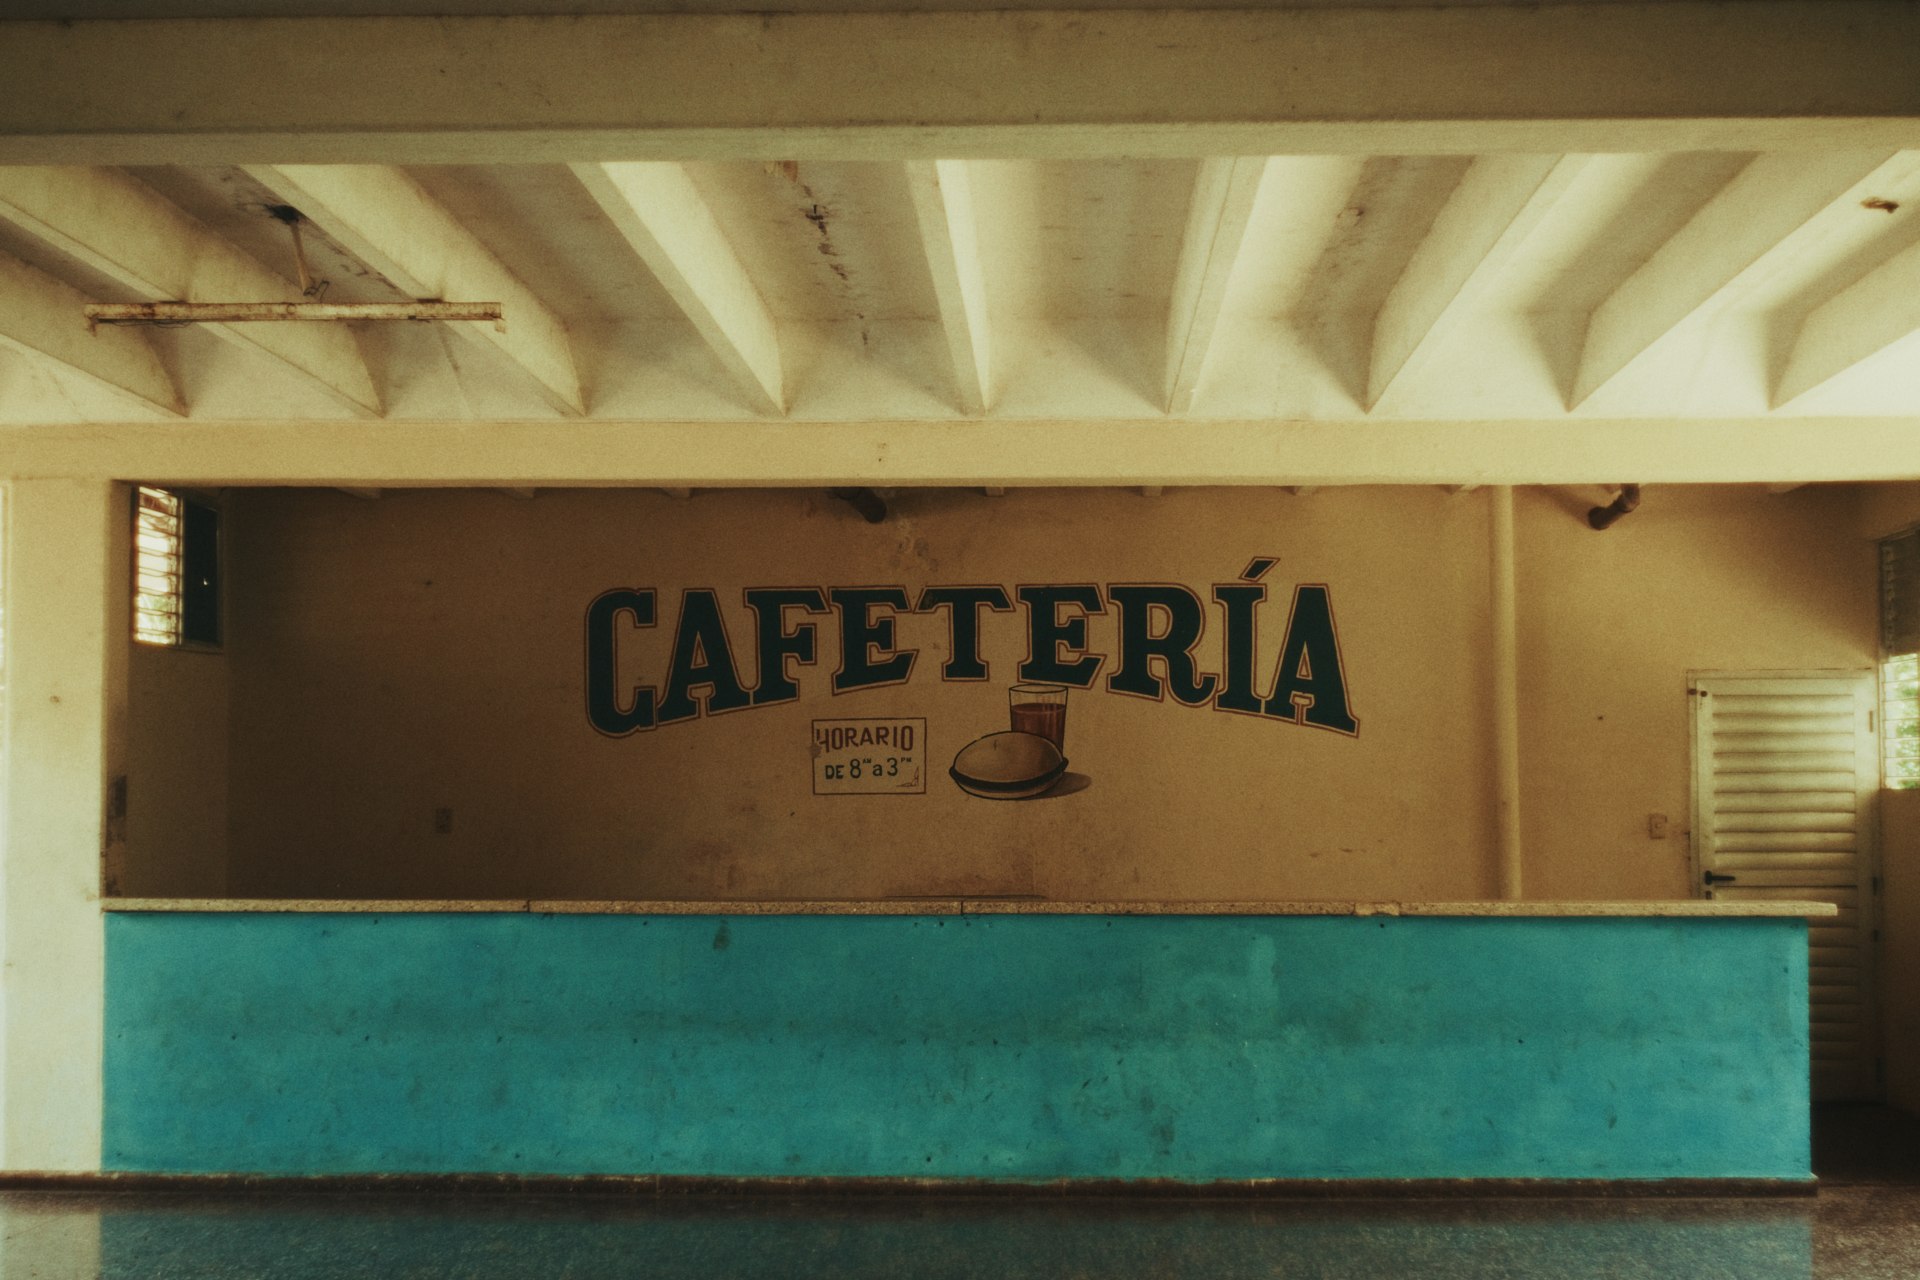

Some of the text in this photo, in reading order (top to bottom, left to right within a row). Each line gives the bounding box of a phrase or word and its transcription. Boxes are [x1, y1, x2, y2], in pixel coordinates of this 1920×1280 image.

[584, 557, 1361, 738] CAFETERÍA
[815, 725, 914, 753] HORARIO
[824, 764, 845, 780] DE
[872, 763, 883, 777] a
